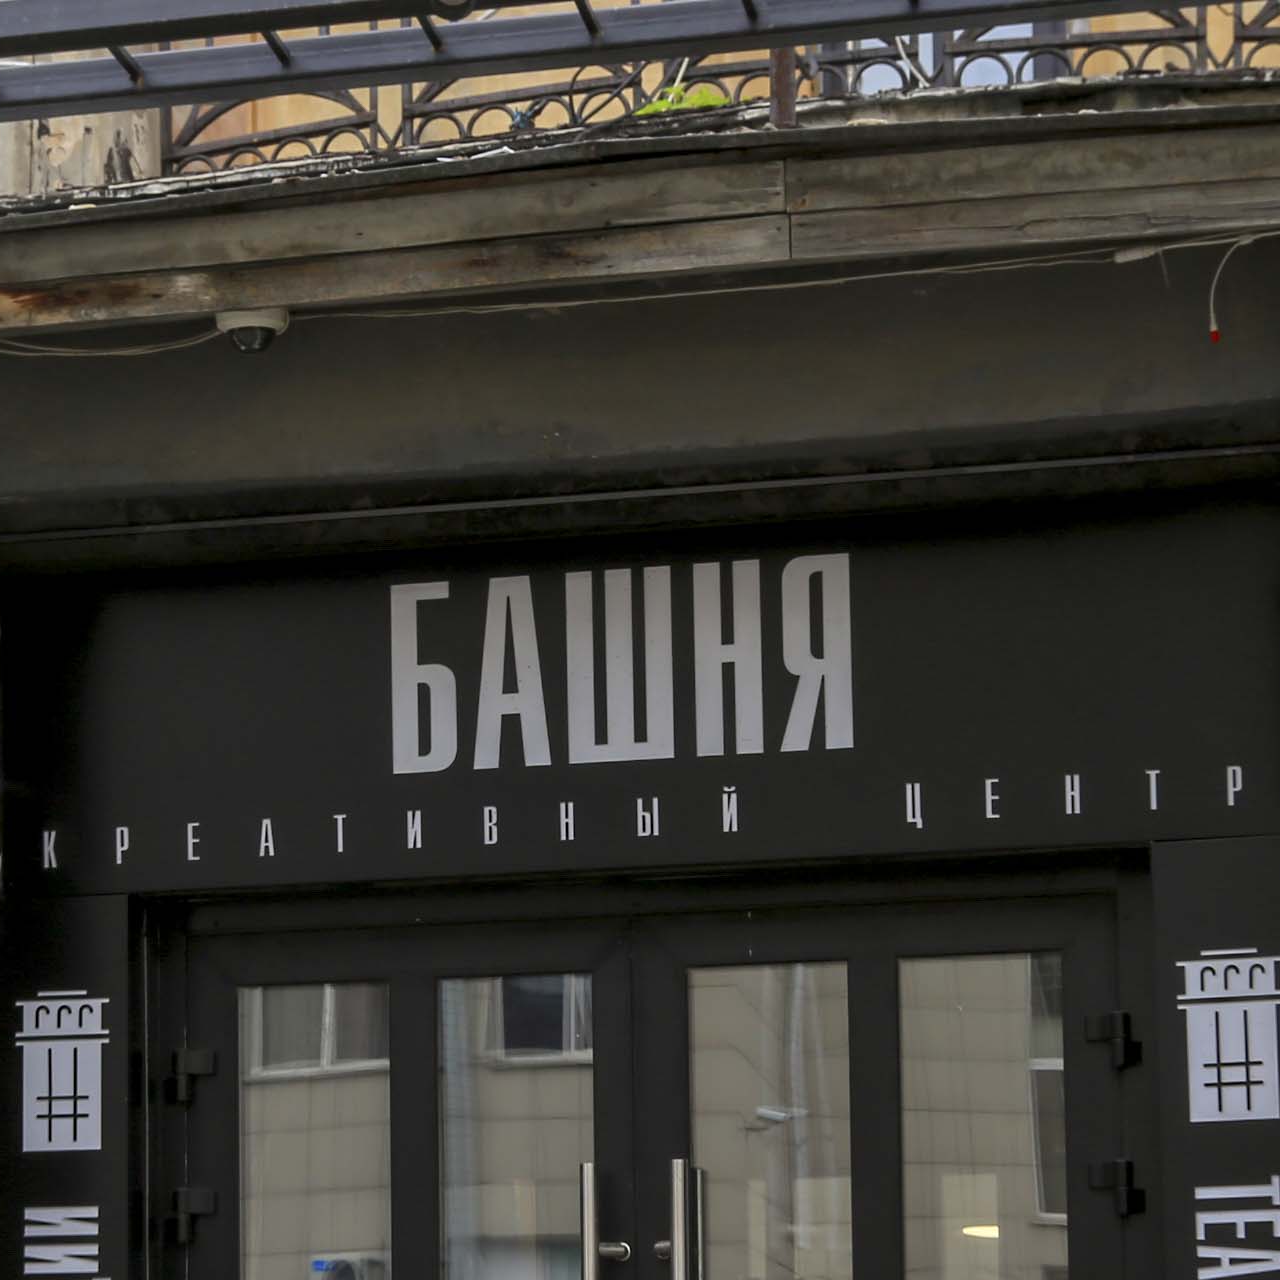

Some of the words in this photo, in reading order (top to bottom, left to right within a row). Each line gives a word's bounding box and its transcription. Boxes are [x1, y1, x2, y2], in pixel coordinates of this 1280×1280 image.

[389, 552, 855, 775] БАШНЯ
[41, 785, 739, 869] КРЕАТИВНЫЙ
[904, 765, 1243, 829] ЦЕНТР
